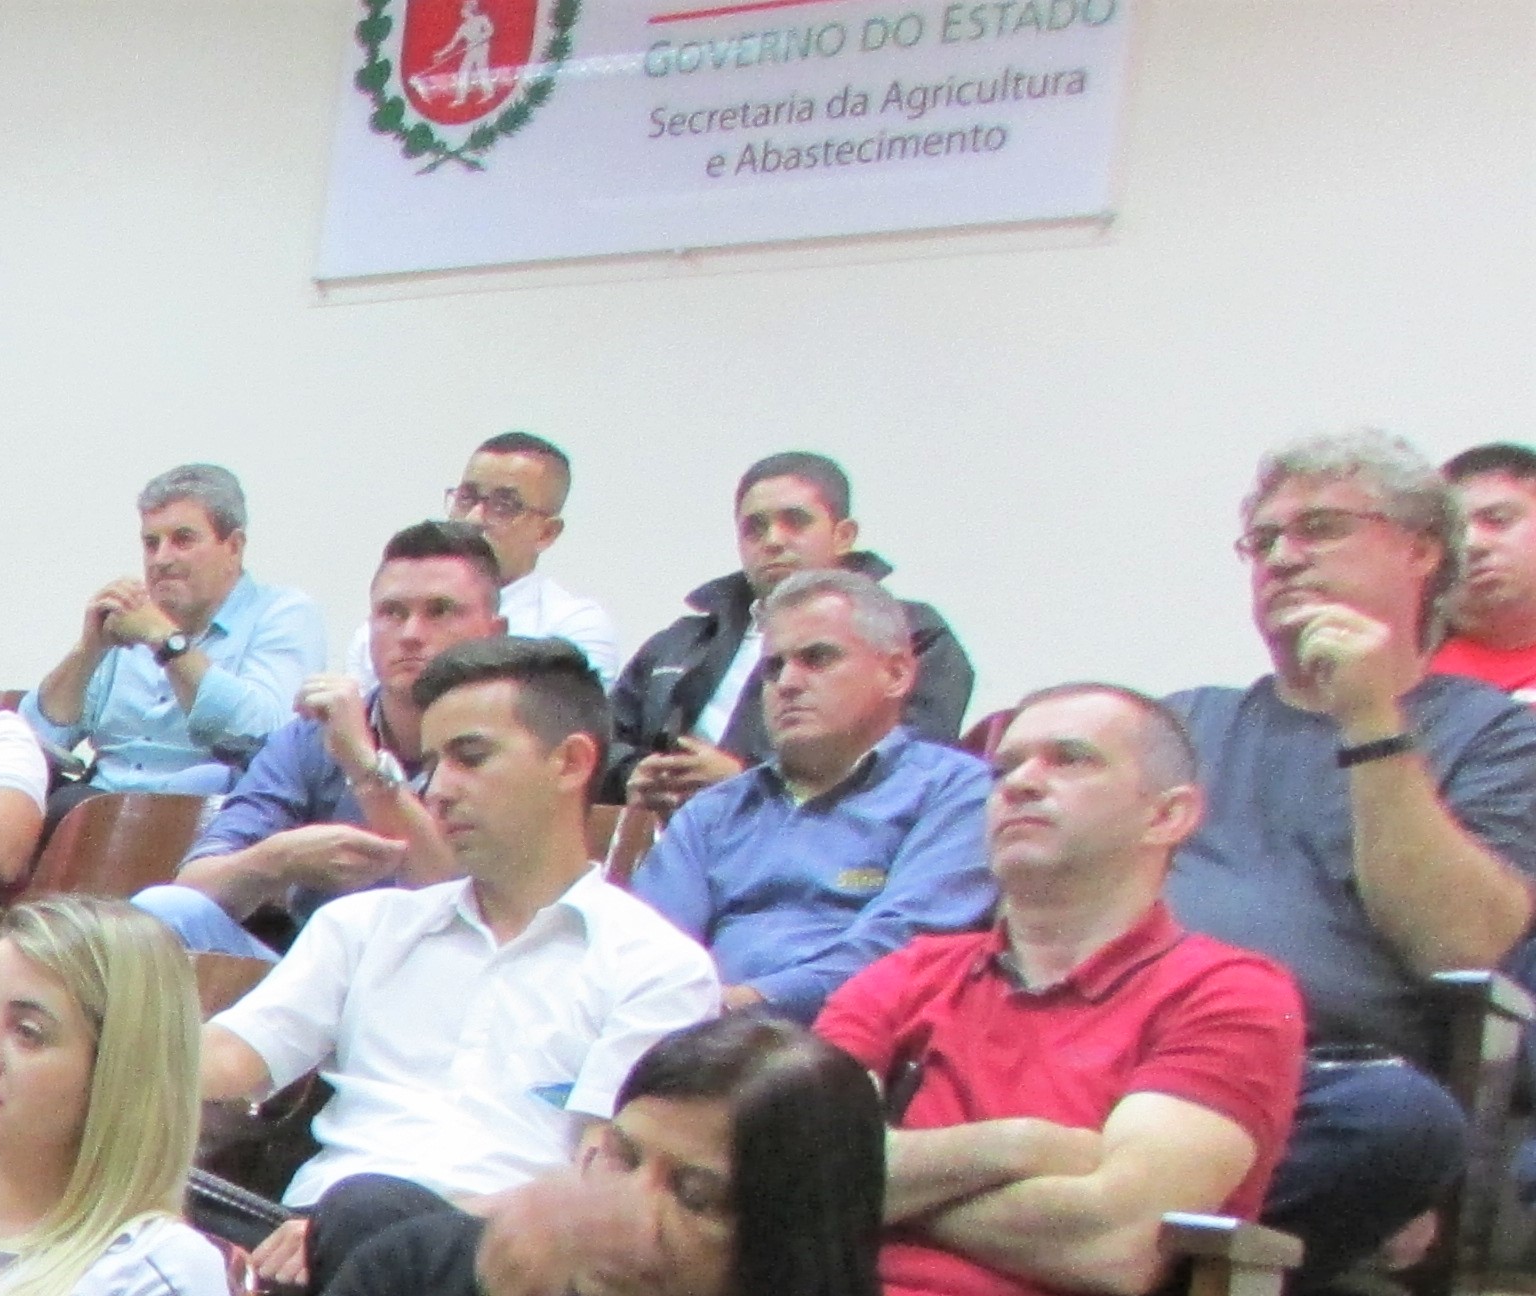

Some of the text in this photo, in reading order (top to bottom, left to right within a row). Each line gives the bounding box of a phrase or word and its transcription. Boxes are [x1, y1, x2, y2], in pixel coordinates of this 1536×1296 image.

[644, 0, 1117, 78] GOVERNO DO ESTADO
[648, 65, 1086, 138] Secretaria da Agricultura
[705, 123, 1007, 178] e Abastecimento
